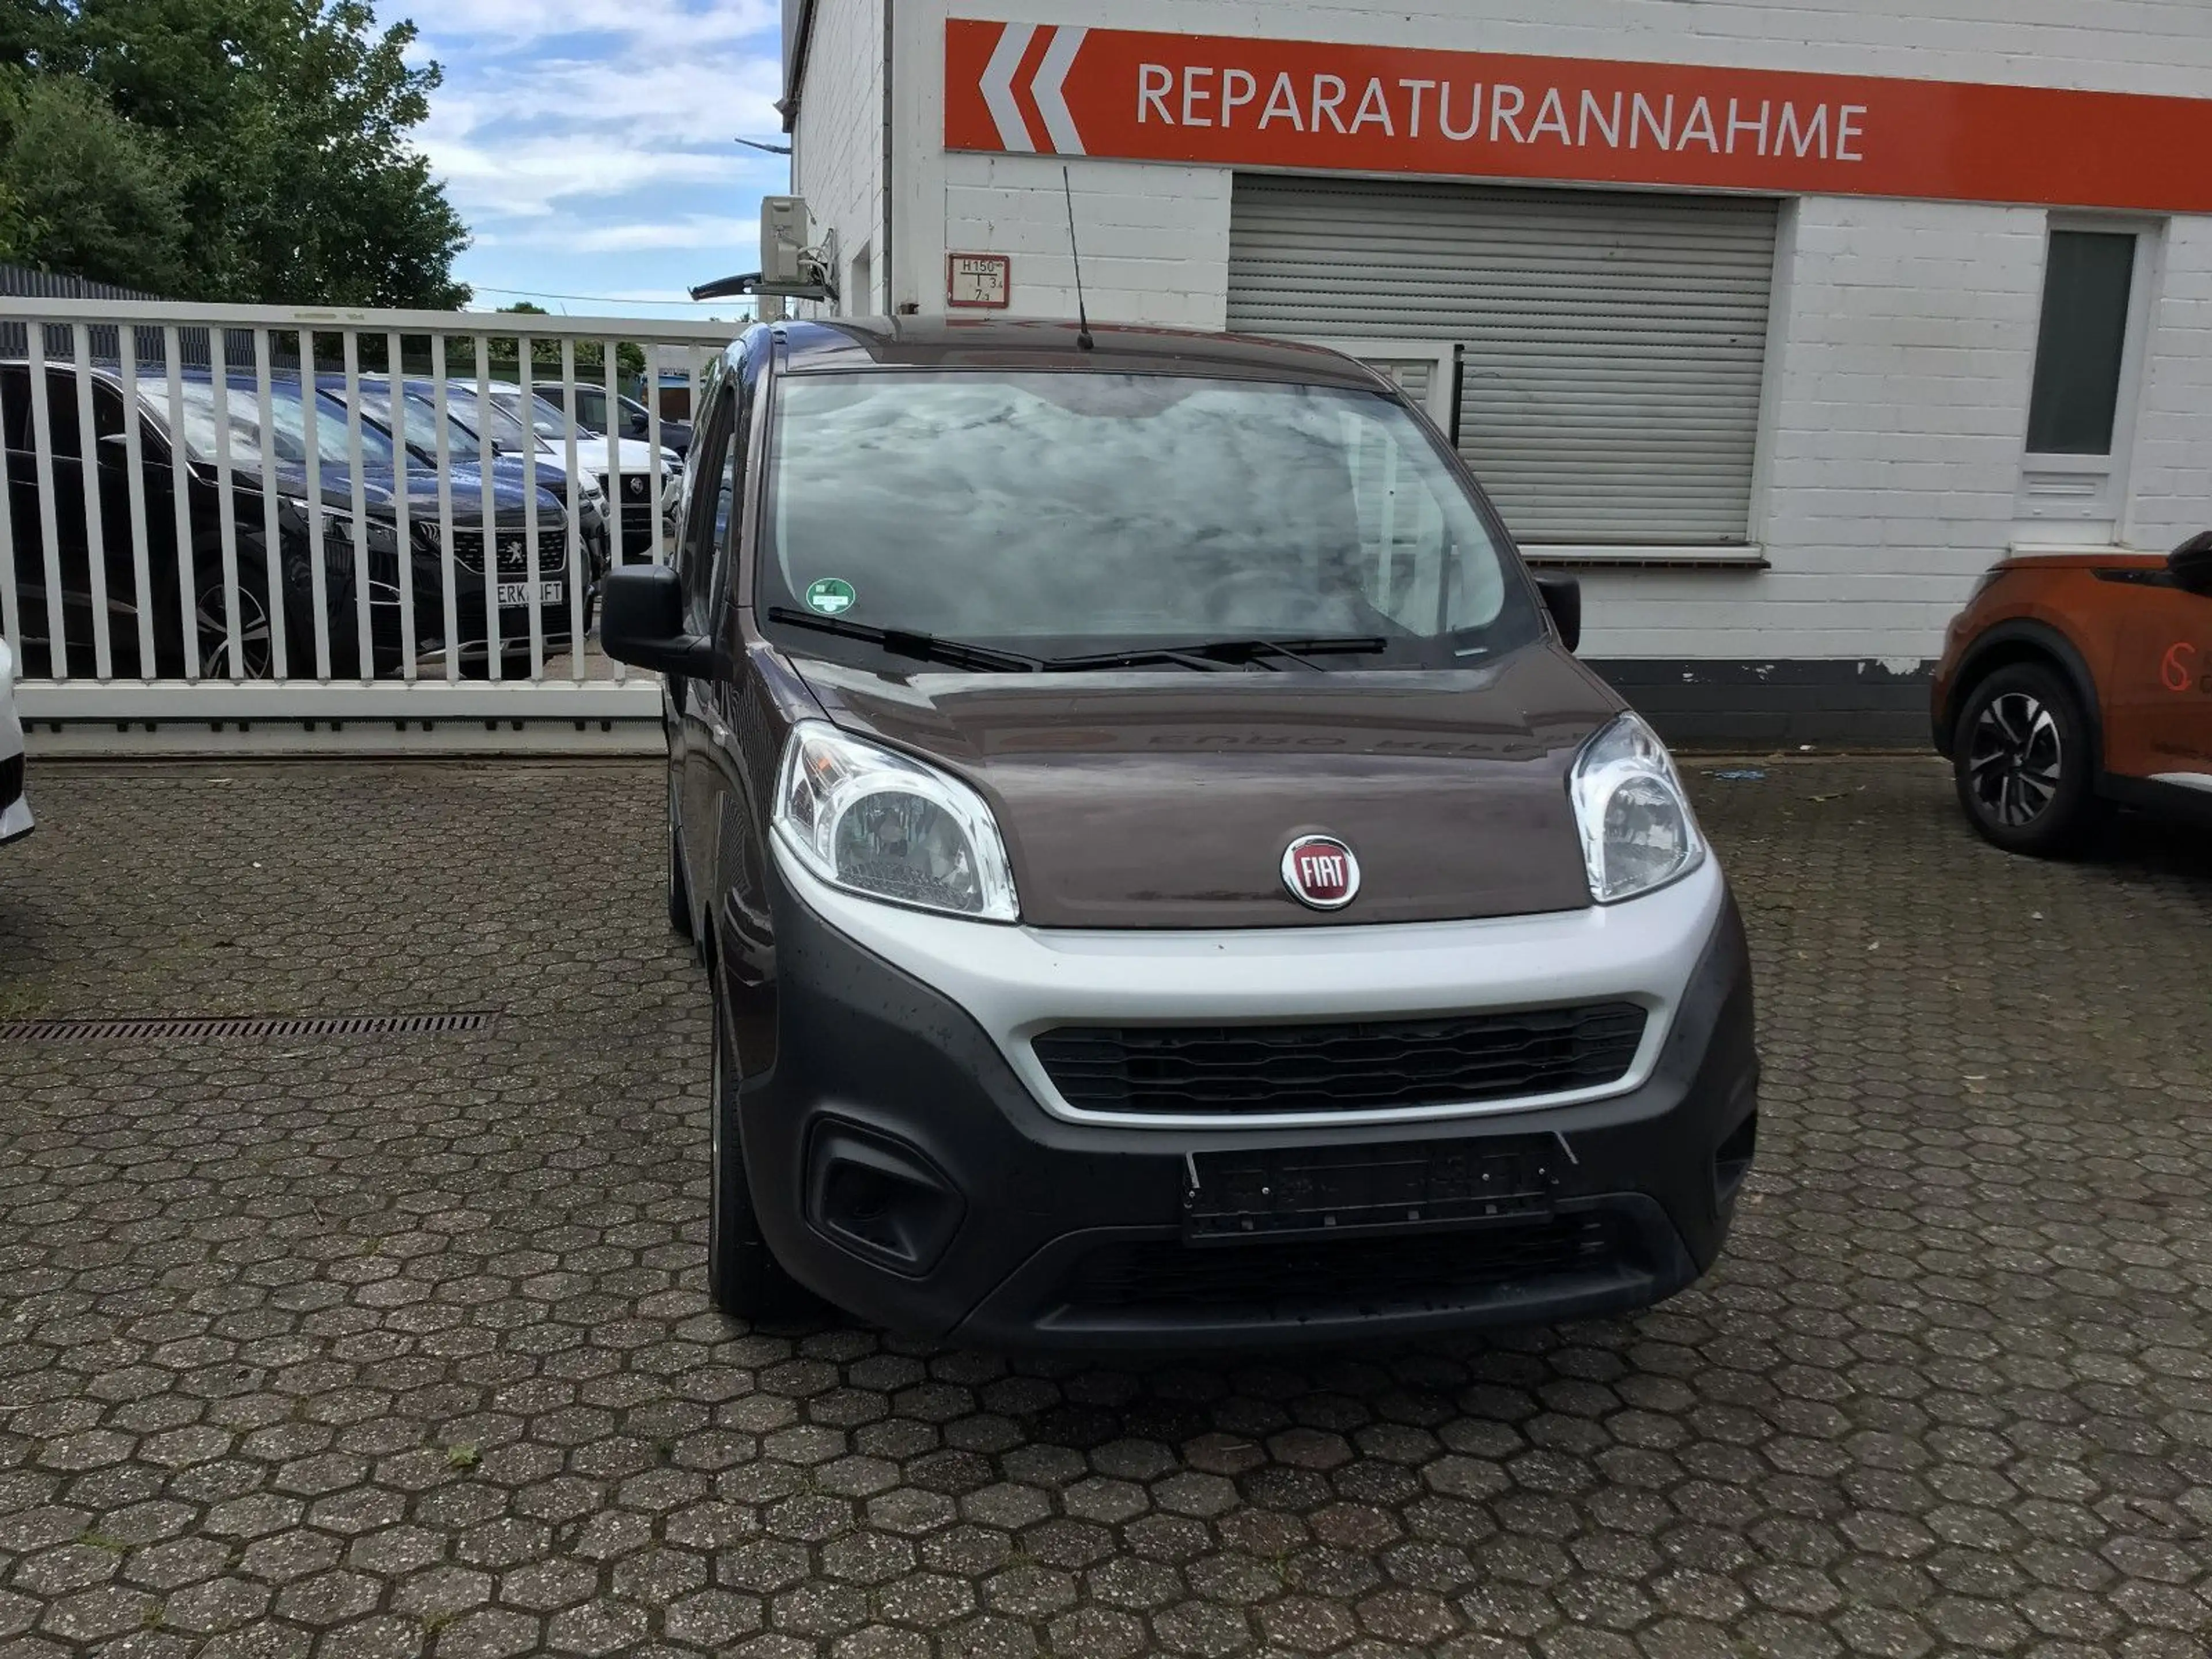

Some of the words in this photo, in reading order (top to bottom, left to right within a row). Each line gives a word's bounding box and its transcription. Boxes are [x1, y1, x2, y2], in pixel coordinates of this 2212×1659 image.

[1138, 63, 1867, 161] REPARATURANNAHME
[497, 582, 561, 603] ERKFT
[2162, 642, 2196, 691] 6
[1301, 855, 1343, 888] FIAT
